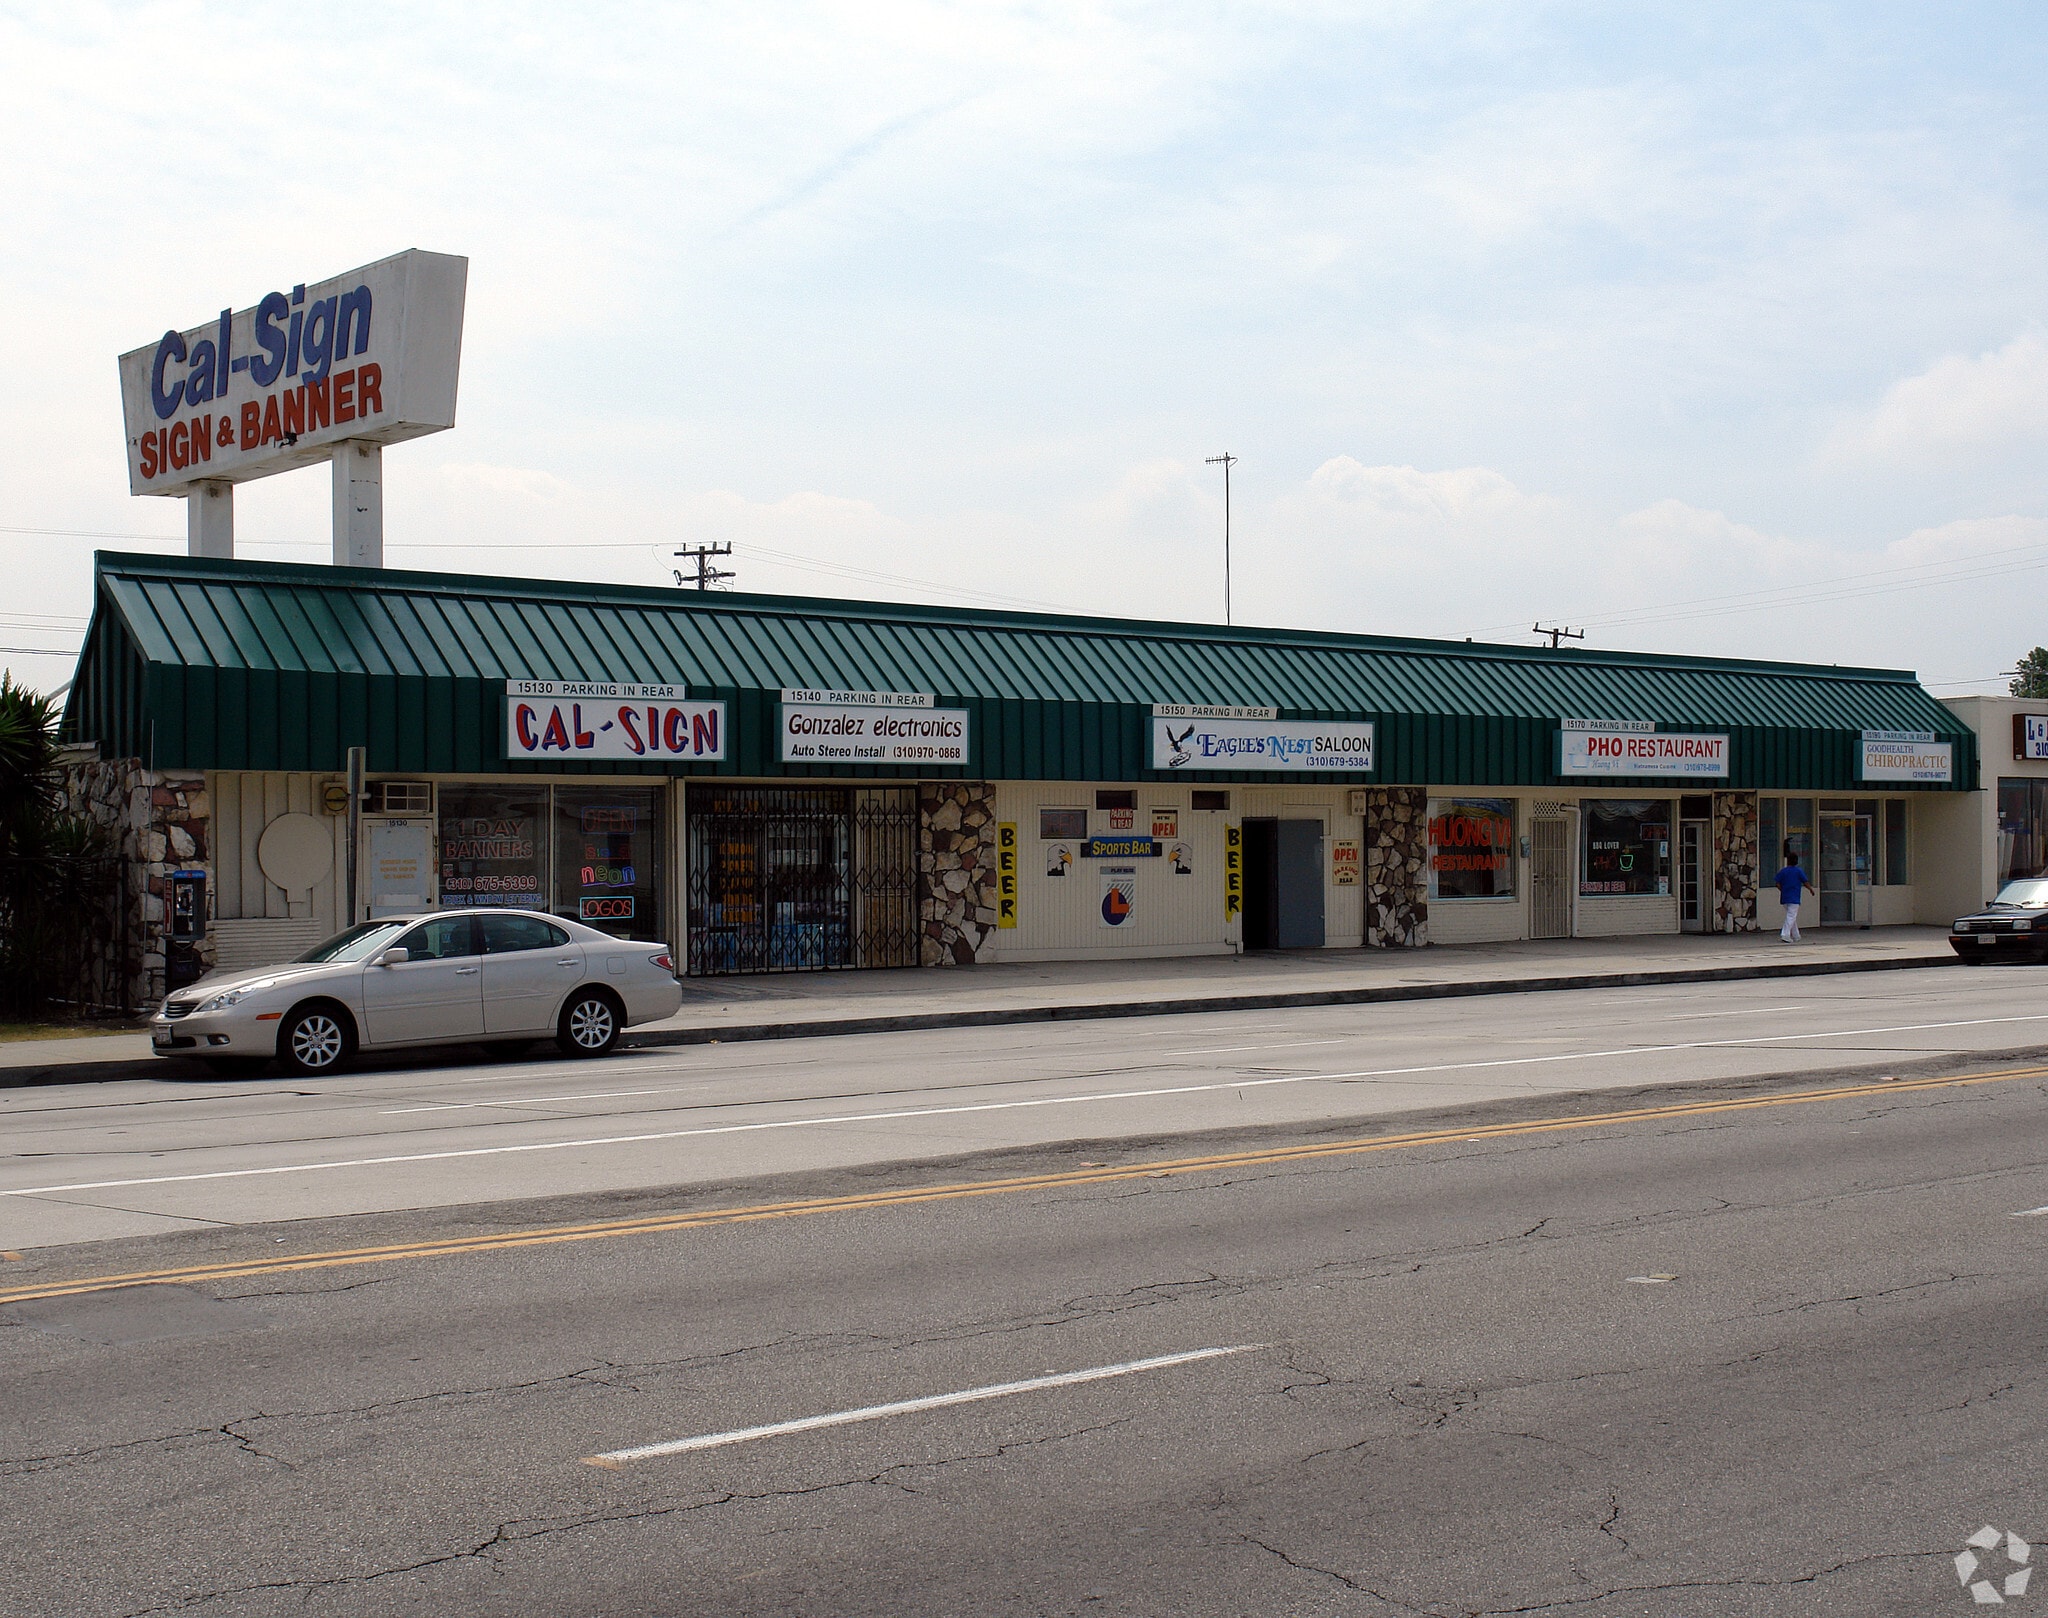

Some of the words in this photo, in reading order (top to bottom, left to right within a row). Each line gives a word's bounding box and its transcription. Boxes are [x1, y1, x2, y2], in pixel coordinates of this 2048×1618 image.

[152, 284, 373, 420] Cal-Sign
[140, 414, 211, 479] SIGN
[216, 416, 234, 447] &
[240, 363, 383, 451] BANNER
[518, 682, 553, 694] 15130
[562, 684, 617, 695] PARKING
[623, 685, 635, 696] IN
[642, 686, 674, 697] REAR
[791, 691, 821, 702] 15140
[829, 693, 876, 703] PARKING
[882, 695, 892, 704] IN
[897, 696, 925, 705] REAR
[1161, 706, 1186, 715] 15150
[1192, 707, 1230, 717] PARKING
[1234, 709, 1243, 717] IN
[1247, 709, 1270, 718] REAR
[516, 703, 718, 755] CAL-SIGN
[788, 714, 865, 735] Gonzalez
[873, 715, 962, 738] electronics
[1566, 720, 1586, 728] 15170
[1590, 721, 1619, 730] PARKING
[1622, 722, 1629, 730] IN
[1632, 723, 1650, 731] REAR
[2028, 720, 2035, 740] L
[1884, 732, 1907, 740] PARKING
[791, 744, 815, 757] Auto
[818, 745, 851, 757] Stereo
[854, 746, 885, 758] Install
[893, 746, 960, 759] (310)970-0868
[1267, 736, 1314, 762] NEST
[1315, 737, 1371, 752] SALOON
[1588, 737, 1623, 757] PHO
[1627, 739, 1722, 758] RESTAURANT
[1867, 744, 1914, 753] GOODHEALTH
[1306, 757, 1369, 767] (310)679-5384
[1866, 754, 1947, 768] CHIROPRACTIC
[584, 809, 633, 831] OPEN
[1111, 809, 1133, 819] PARKING
[455, 820, 466, 838] 1
[473, 819, 524, 838] DAY
[1111, 819, 1117, 828] IN
[1118, 819, 1133, 829] REAR
[1152, 822, 1175, 836] OPEN
[444, 840, 533, 859] BANNERS
[1092, 841, 1130, 855] SPORTS
[1131, 841, 1151, 854] BAR
[1604, 841, 1619, 850] LOVER
[1334, 849, 1358, 860] OPEN
[1432, 855, 1508, 870] RESTAURANT
[581, 865, 635, 884] neon
[1000, 828, 1015, 918] BEER
[1228, 829, 1240, 912] BEER
[1334, 866, 1358, 876] PARKING
[445, 878, 473, 890] (310)
[474, 875, 537, 890] 675-5399
[474, 894, 503, 904] WINDOW
[504, 893, 541, 904] LETTERING
[582, 900, 631, 917] LOGOS
